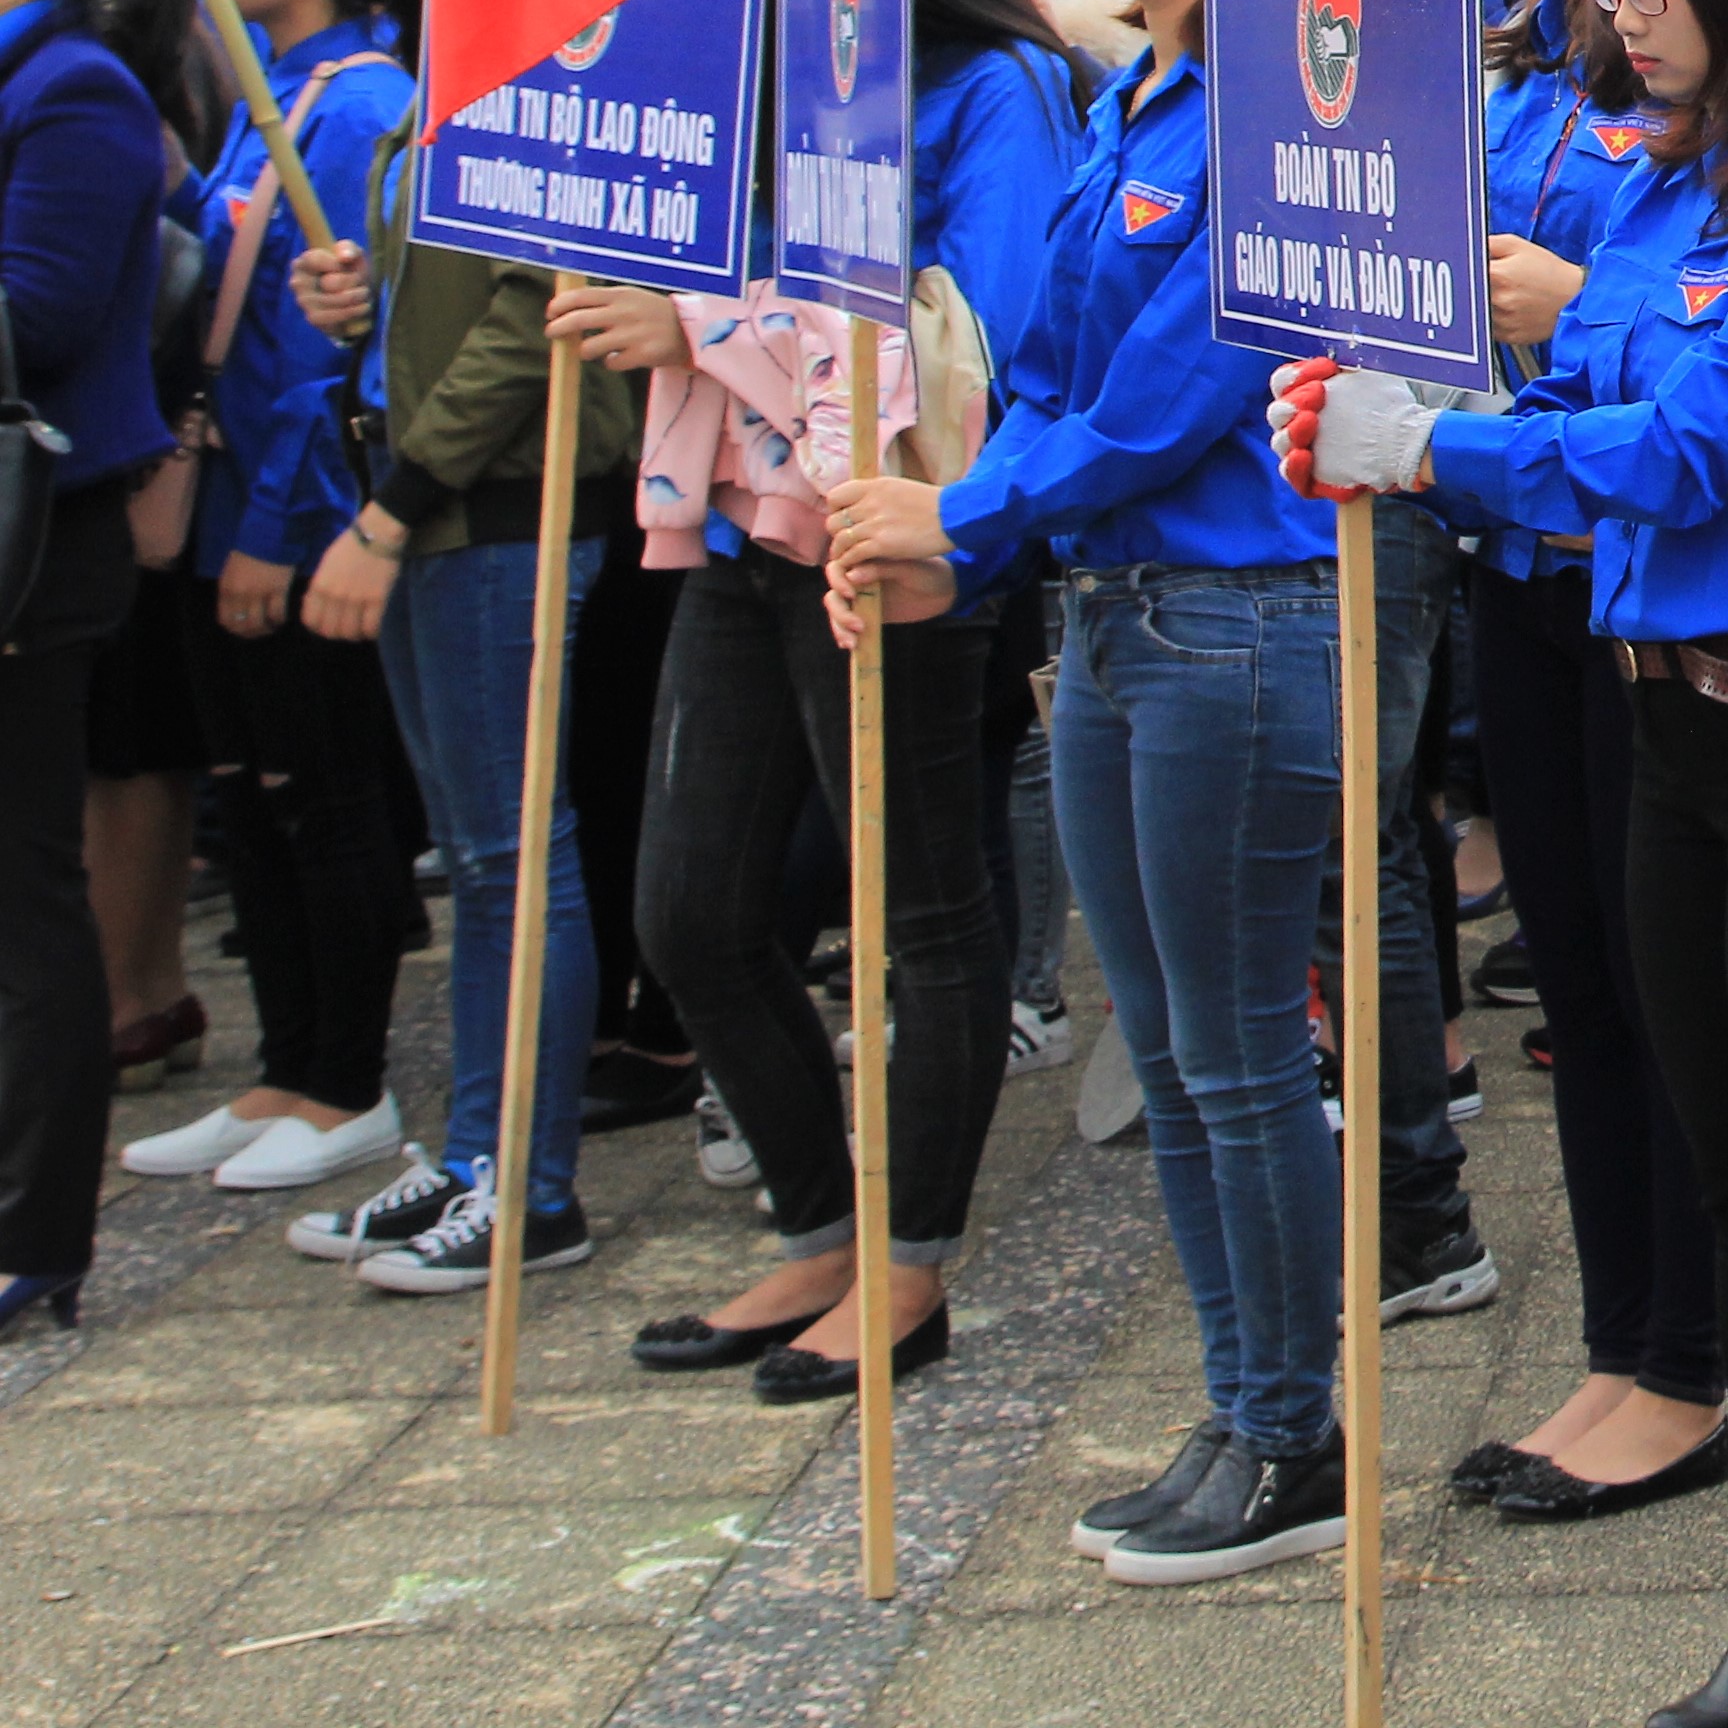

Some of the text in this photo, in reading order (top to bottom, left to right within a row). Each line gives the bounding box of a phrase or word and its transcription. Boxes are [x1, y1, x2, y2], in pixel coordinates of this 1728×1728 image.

[518, 87, 550, 140] TN
[550, 84, 584, 158] BỘ
[586, 98, 637, 155] LAO
[639, 97, 716, 172] ĐỘNG
[457, 155, 699, 254] THƯƠNG BINH XÃ HỘI
[1274, 131, 1396, 232] ĐOÀN TN BỘ
[1235, 222, 1454, 340] GIÁO DỤC VÀ ĐÀO TẠO
